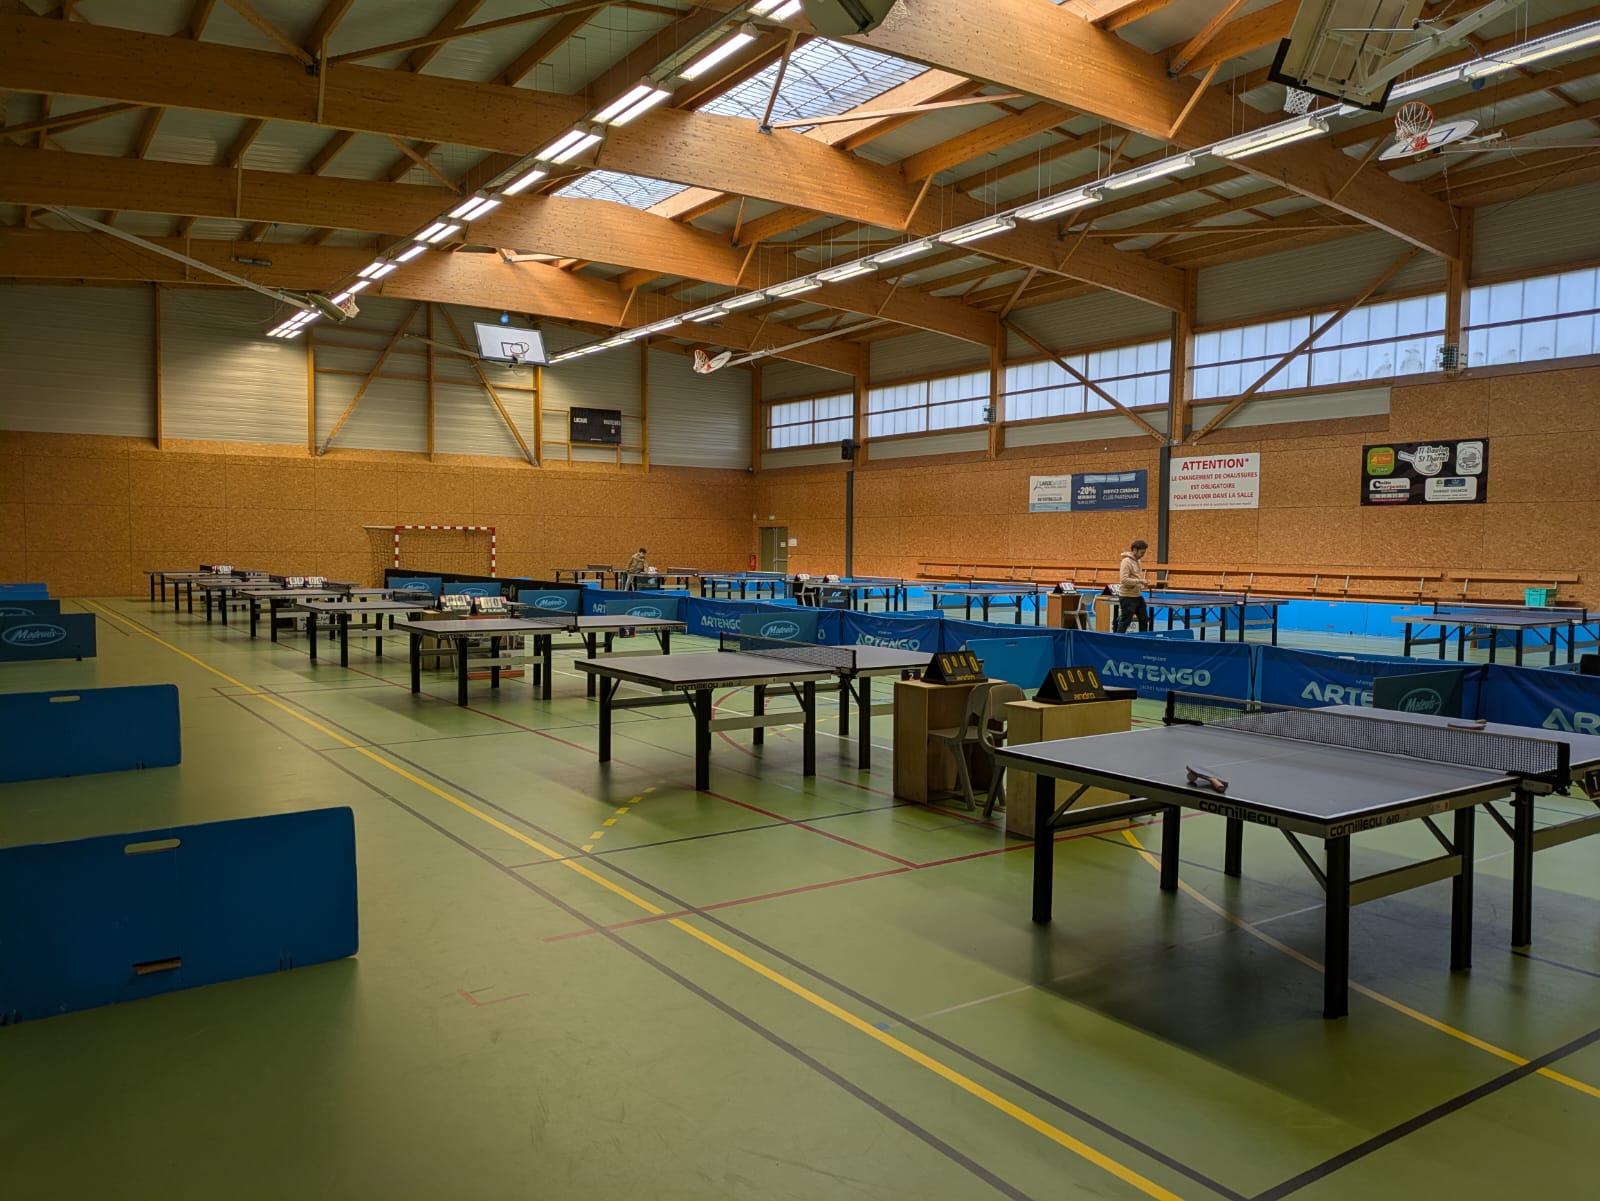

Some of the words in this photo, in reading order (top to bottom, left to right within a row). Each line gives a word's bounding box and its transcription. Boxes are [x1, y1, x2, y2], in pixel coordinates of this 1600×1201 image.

[1223, 471, 1258, 479] CHAUSSURES
[1077, 486, 1096, 495] -20%
[908, 672, 914, 680] 2
[1102, 659, 1211, 687] ARTENGO
[1200, 800, 1278, 827] cornilleau
[1330, 815, 1381, 837] cornilleau
